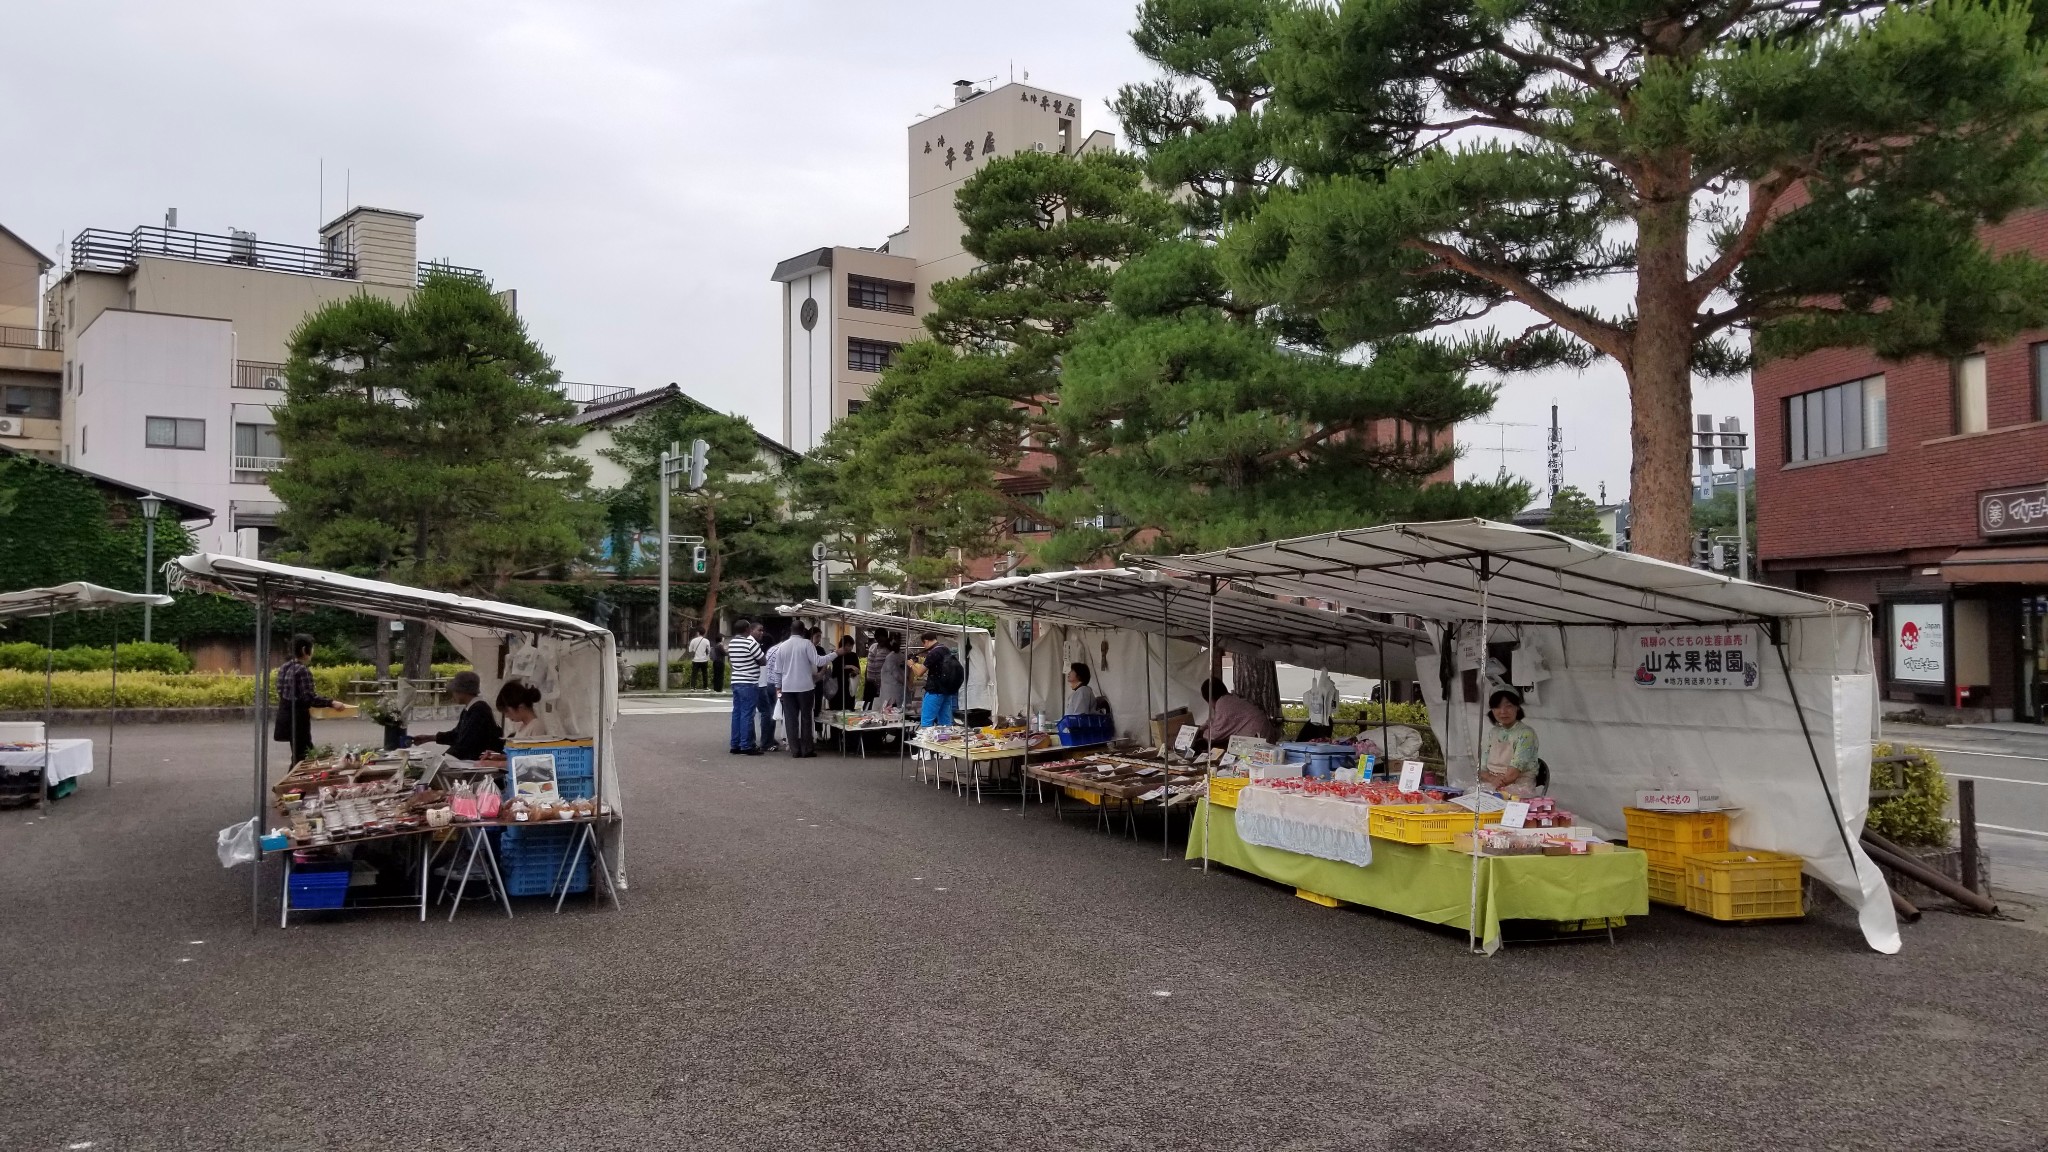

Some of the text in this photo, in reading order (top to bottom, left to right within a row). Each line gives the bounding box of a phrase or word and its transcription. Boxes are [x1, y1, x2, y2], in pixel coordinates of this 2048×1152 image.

[2009, 497, 2048, 523] マツモト
[1645, 650, 1743, 673] 山本果樹園
